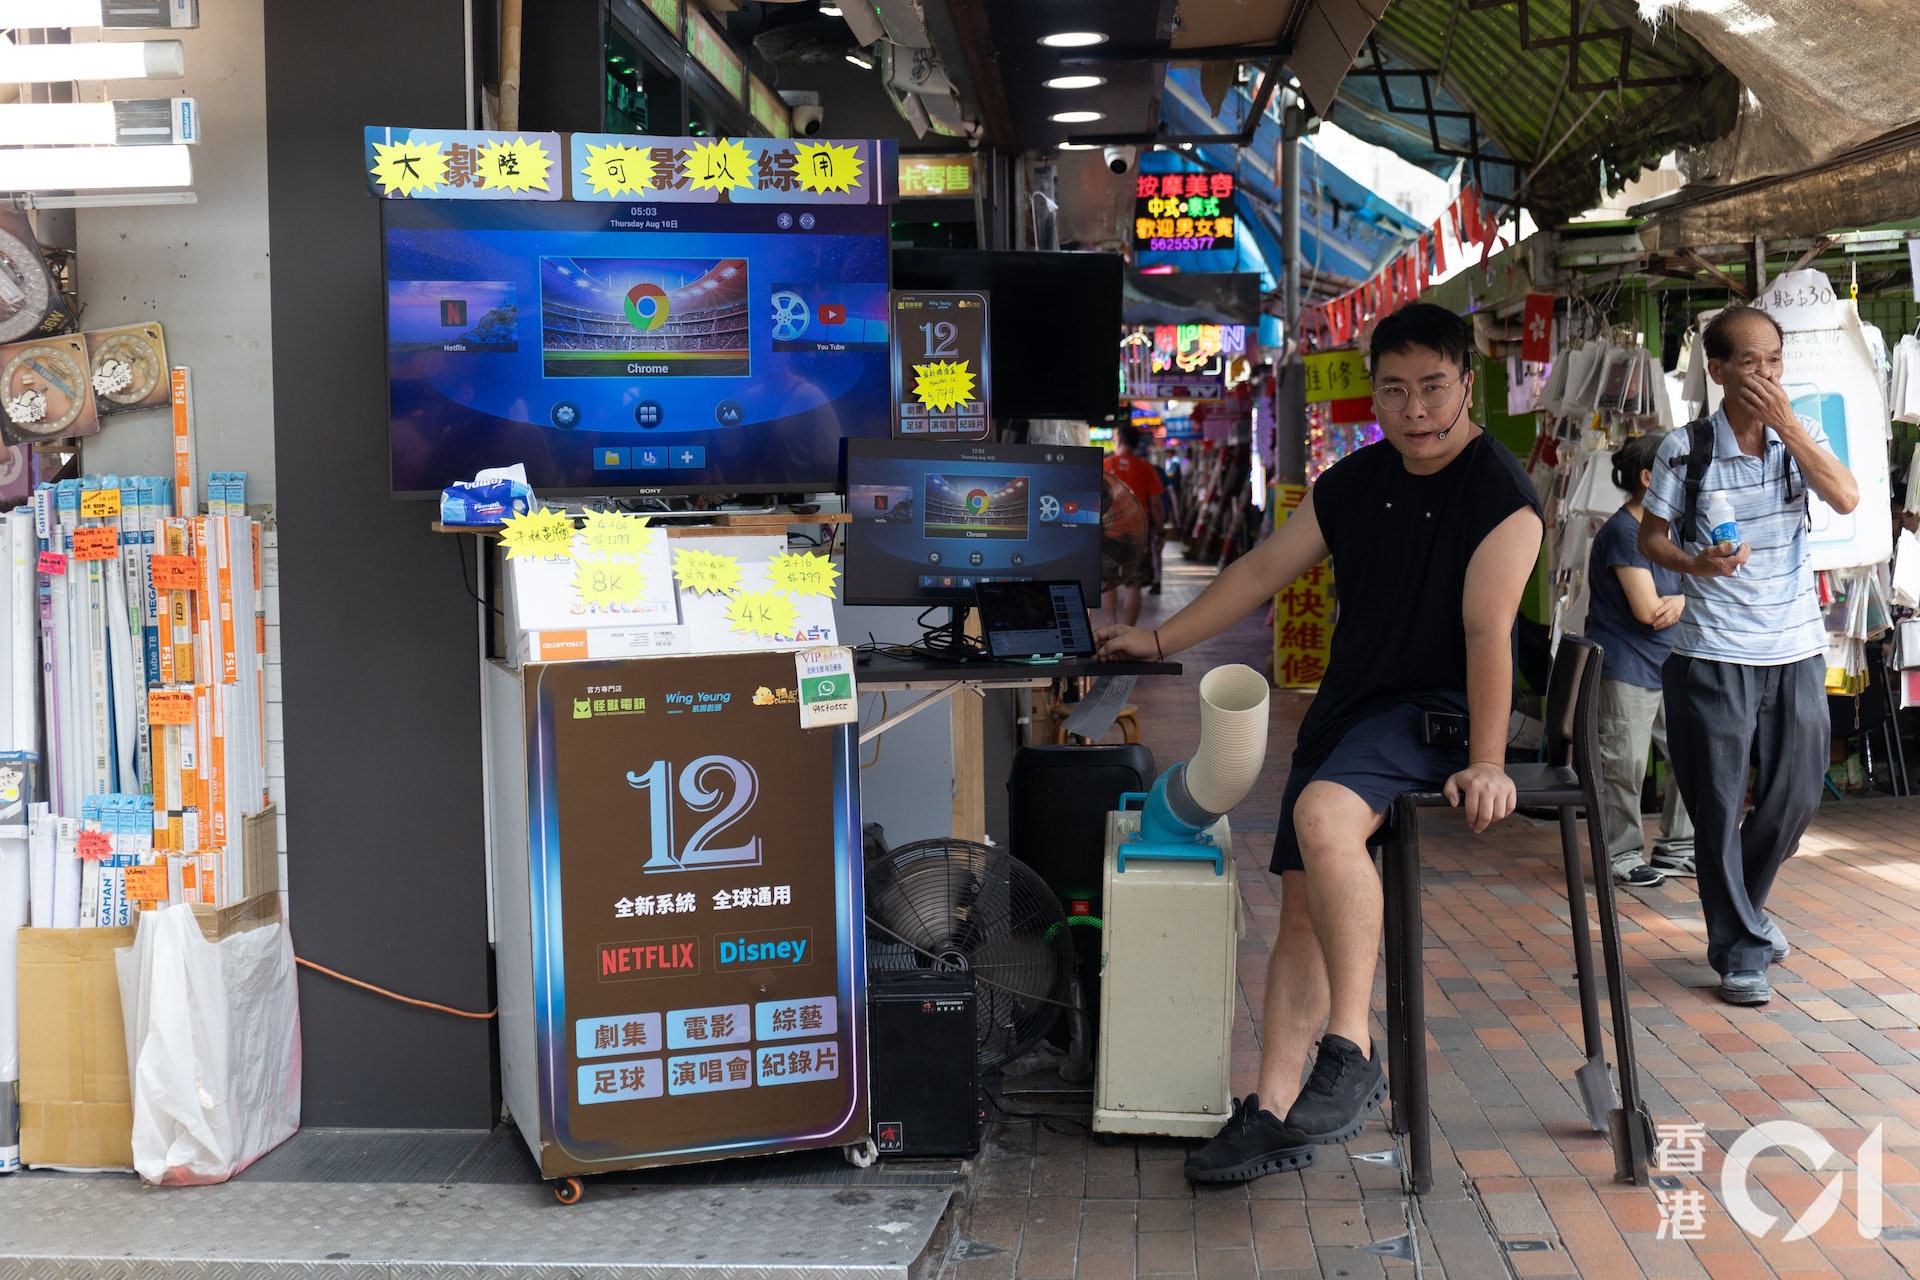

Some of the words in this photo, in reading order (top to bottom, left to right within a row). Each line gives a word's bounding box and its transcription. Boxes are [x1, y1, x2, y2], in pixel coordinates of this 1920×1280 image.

[393, 153, 421, 181] 大
[498, 151, 520, 176] 陸
[605, 158, 627, 184] 可
[703, 153, 735, 181] 以
[812, 151, 833, 178] 用
[898, 165, 969, 192] 卡零售
[1136, 172, 1233, 198] 按摩美容
[630, 207, 657, 216] 05:03
[610, 220, 644, 229] Thursday
[645, 221, 660, 229] Aug
[661, 220, 678, 229] 10日
[1135, 216, 1234, 239] 歡迎男女賓
[1150, 237, 1215, 250] 56255377
[40, 310, 65, 332] 36W
[816, 343, 828, 351] You
[829, 343, 845, 351] Tube
[919, 321, 959, 358] 12
[627, 363, 669, 374] Chrome
[175, 383, 185, 404] FSL
[906, 421, 923, 430] 足球
[931, 420, 956, 430] 演唱會
[960, 419, 984, 429] 紀錄片
[37, 494, 46, 535] PHILIPS
[965, 531, 987, 539] Chrome
[592, 571, 623, 592] 8K
[742, 603, 773, 623] 4K
[149, 635, 157, 655] T8
[161, 646, 171, 668] FSL
[225, 652, 235, 674] FSL
[802, 652, 821, 663] VIP
[150, 657, 158, 682] Tube
[586, 685, 623, 694] 官方專門店
[666, 691, 694, 705] Wing
[697, 691, 731, 703] Yeung
[593, 697, 646, 712] 怪獸電訊
[216, 813, 225, 837] LED
[626, 755, 763, 875] 12
[614, 892, 697, 918] 全新系統
[712, 885, 791, 910] 全球通用
[602, 943, 694, 976] NETFLIX
[719, 938, 807, 963] Disney
[683, 1012, 735, 1040] 電影
[772, 1004, 823, 1032] 綜藝
[594, 1021, 647, 1050] 劇集
[672, 1055, 750, 1087] 演唱會
[761, 1047, 837, 1078] 紀錄片
[593, 1066, 646, 1095] 足球
